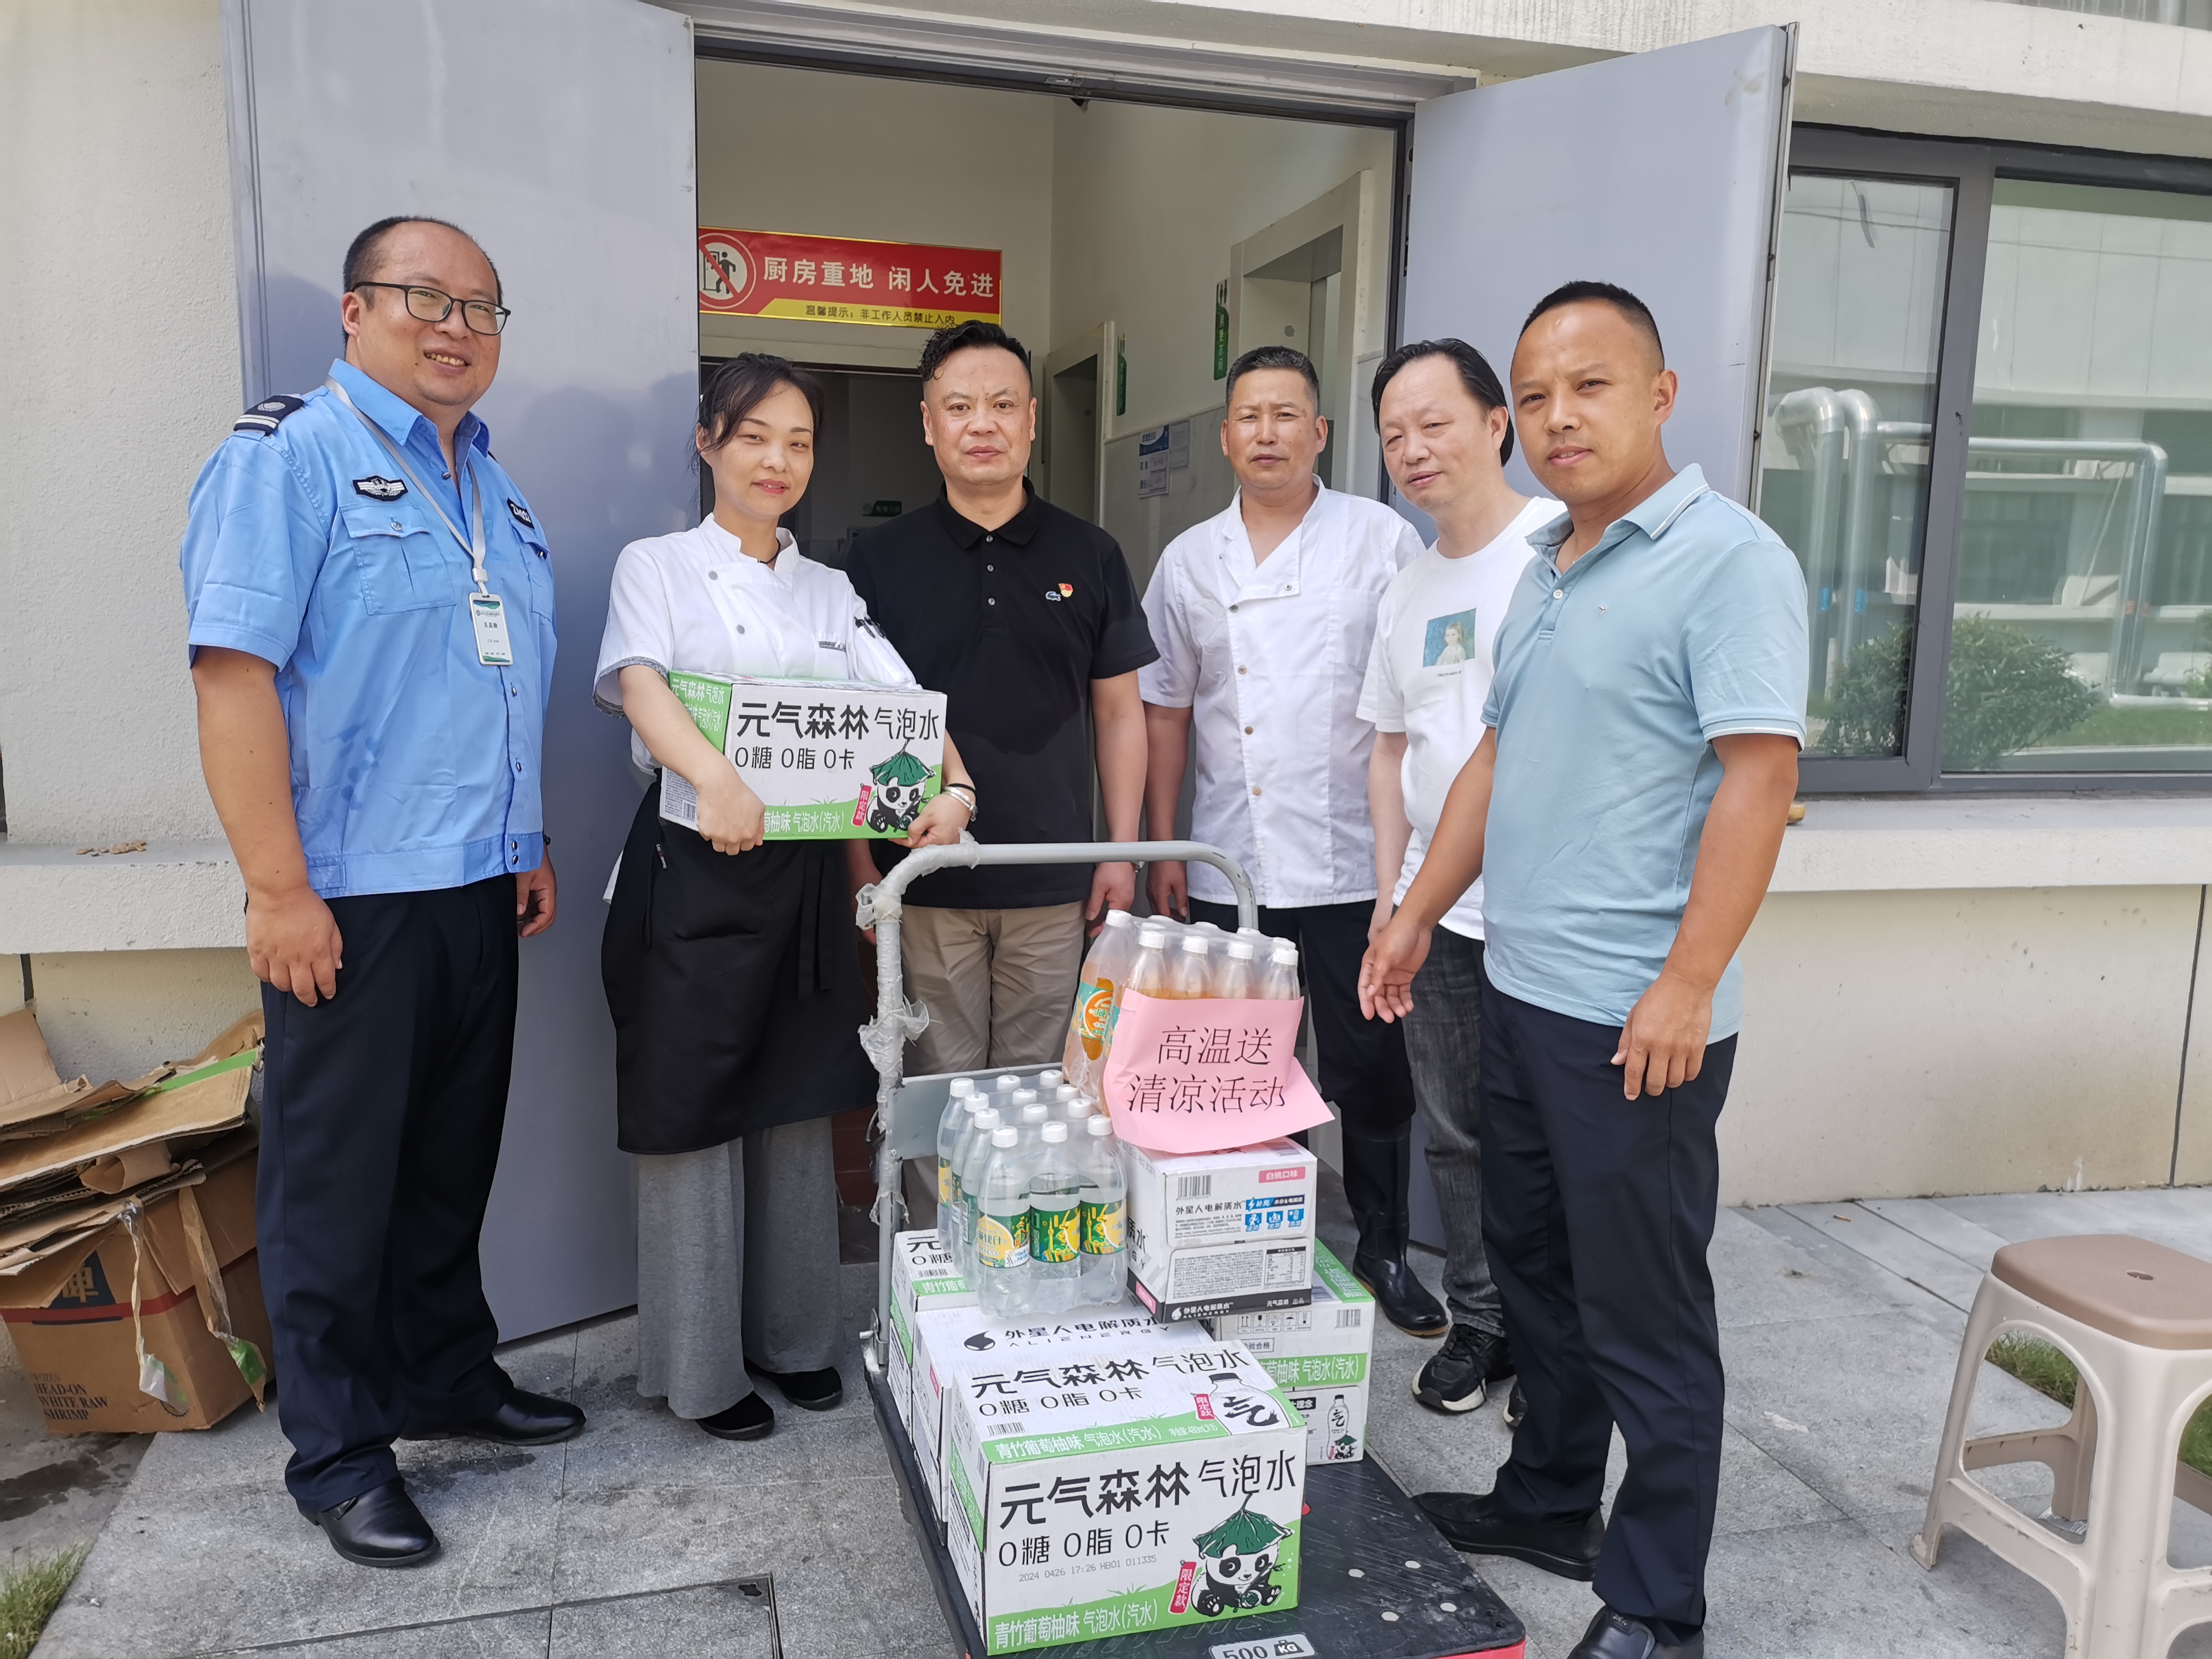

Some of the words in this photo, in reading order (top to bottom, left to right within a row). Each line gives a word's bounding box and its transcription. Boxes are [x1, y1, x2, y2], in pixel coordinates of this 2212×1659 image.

[763, 256, 874, 289] 厨房重地
[888, 266, 994, 298] 闲人免进
[737, 701, 870, 740] 元气森林
[874, 706, 939, 740] 气泡水
[735, 746, 773, 769] 0糖
[781, 747, 816, 770] 0脂
[824, 748, 855, 770] 0卡
[855, 790, 869, 823] 限定款
[1158, 1025, 1273, 1066] 高温送
[1126, 1073, 1286, 1114] 清凉活动
[1175, 1202, 1241, 1216] 外星人电解质水
[907, 1235, 942, 1253] 元
[34, 1383, 88, 1395] HEAD-ON
[970, 1358, 1151, 1399] 元气森林
[1151, 1348, 1251, 1376] 气泡水
[38, 1395, 80, 1408] WHITE
[80, 1396, 108, 1408] RAW
[43, 1408, 89, 1420] SHRIMP
[979, 1397, 1030, 1417] 0糖
[1040, 1392, 1090, 1410] 0脂
[1099, 1385, 1142, 1402] 0卡
[1195, 1396, 1214, 1417] 限定款
[994, 1432, 1085, 1460] 青竹葡萄柚味
[999, 1462, 1191, 1530] 元气森林
[1197, 1449, 1297, 1499] 气泡水
[998, 1533, 1051, 1567] 0糖
[1064, 1527, 1113, 1558] 0脂
[1125, 1519, 1171, 1549] 0卡
[1019, 1571, 1040, 1582] 2024
[1044, 1568, 1066, 1579] 0426
[1071, 1563, 1097, 1575] 17:26
[1173, 1567, 1194, 1610] 限定款
[994, 1611, 1082, 1650] 青竹葡萄柚味
[1222, 1646, 1268, 1659] 500
[1277, 1644, 1298, 1653] KG
